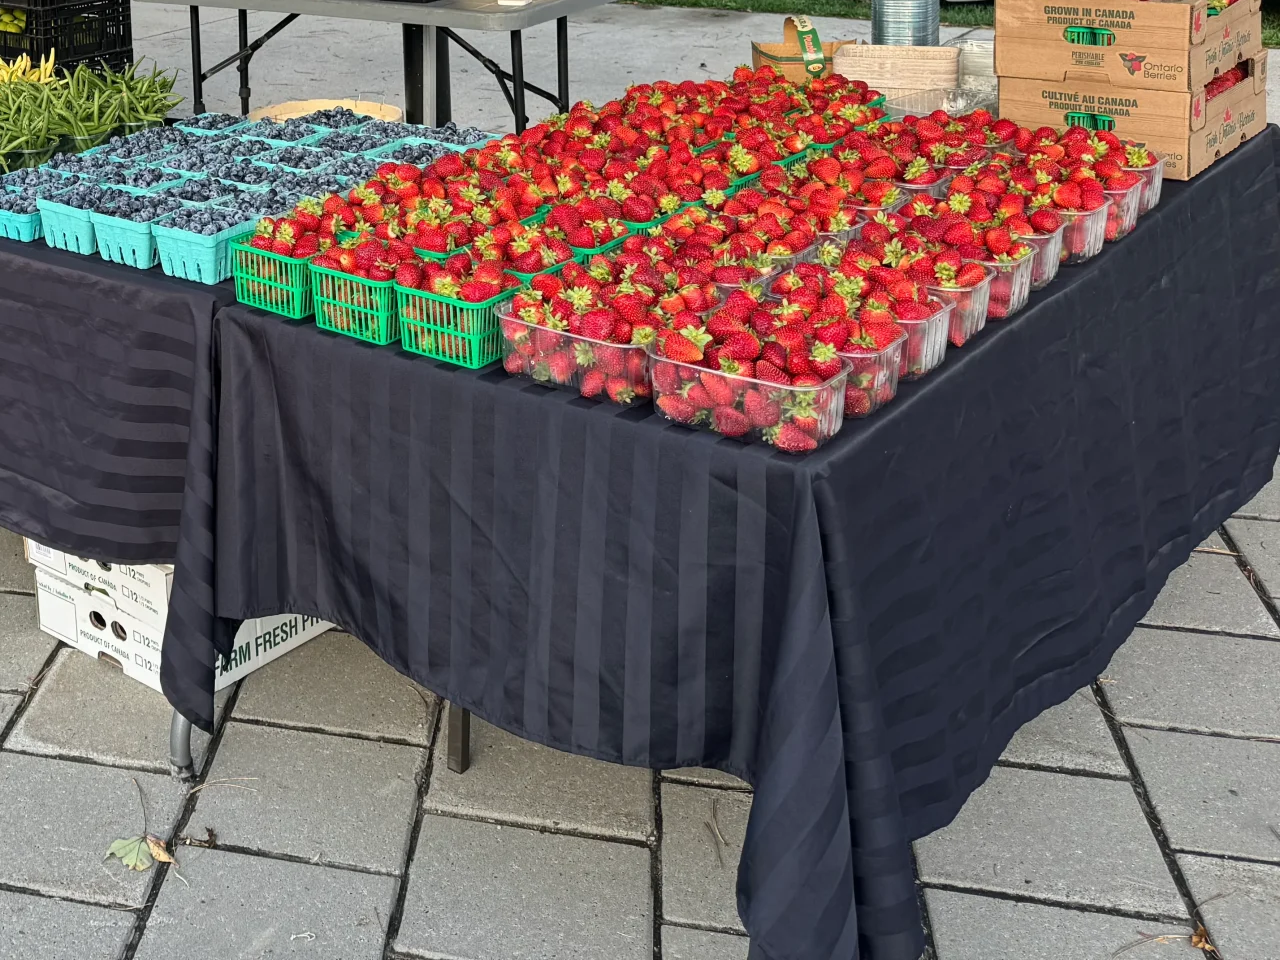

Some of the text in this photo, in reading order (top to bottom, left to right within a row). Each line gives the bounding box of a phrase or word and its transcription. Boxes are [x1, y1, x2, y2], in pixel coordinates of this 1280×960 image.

[1044, 5, 1135, 20] GROWN IN CANADA
[1047, 16, 1084, 26] PRODUCT
[1098, 19, 1132, 29] CANADA
[1071, 51, 1105, 60] PERISHABLE
[1143, 62, 1183, 73] Ontario
[1143, 70, 1177, 81] Berries
[1041, 90, 1138, 108] CULTIVÉ AU CANADA
[1049, 101, 1130, 117] PRODUIT DU CANADA
[68, 562, 117, 592] PRODUCT OF CANADA
[128, 566, 137, 580] 12
[130, 590, 139, 603] 12
[142, 635, 151, 648] 12
[255, 616, 298, 657] FRESH
[80, 629, 130, 660] PRODUCT OF CANADA
[144, 659, 153, 672] 12
